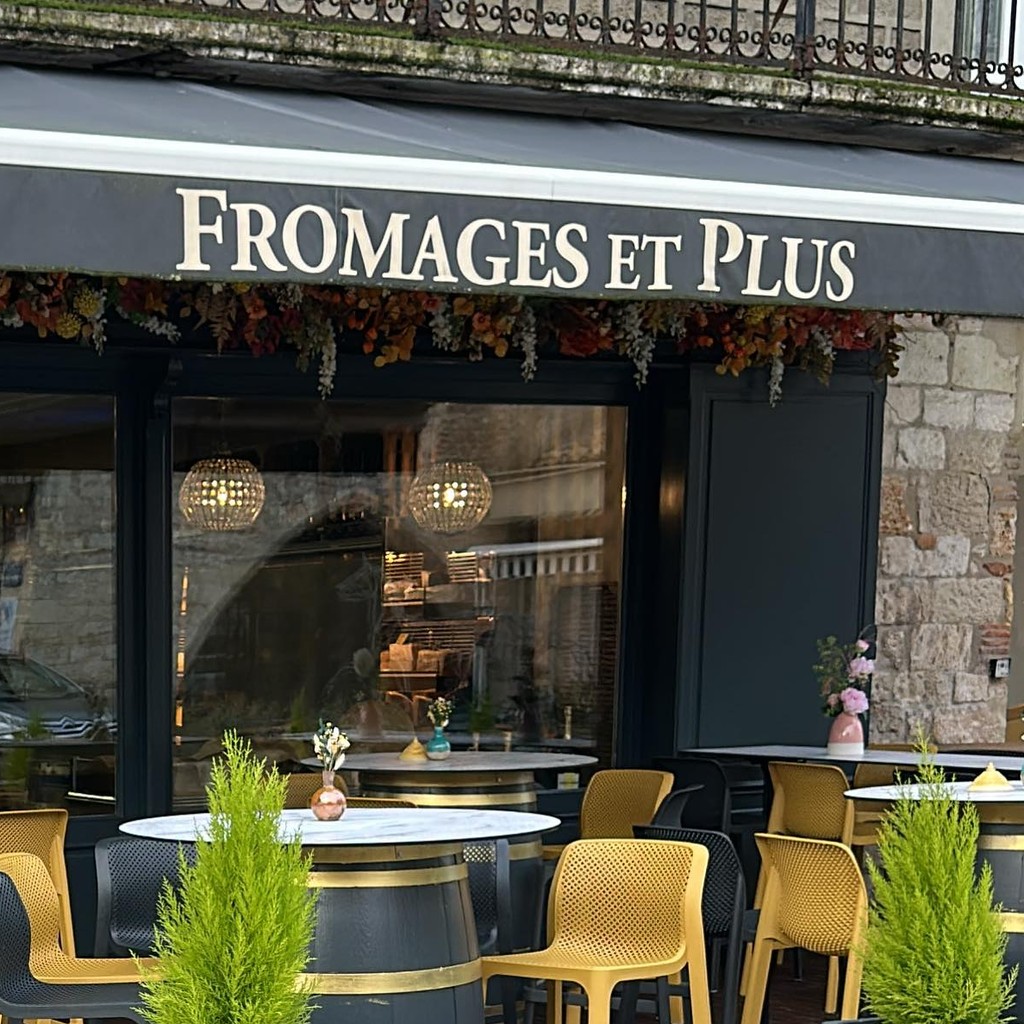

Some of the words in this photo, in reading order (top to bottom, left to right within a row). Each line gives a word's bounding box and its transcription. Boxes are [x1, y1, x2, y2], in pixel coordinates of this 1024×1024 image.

[175, 188, 589, 289] FROMAGES
[605, 234, 683, 290] ET
[697, 218, 856, 302] PLUS
